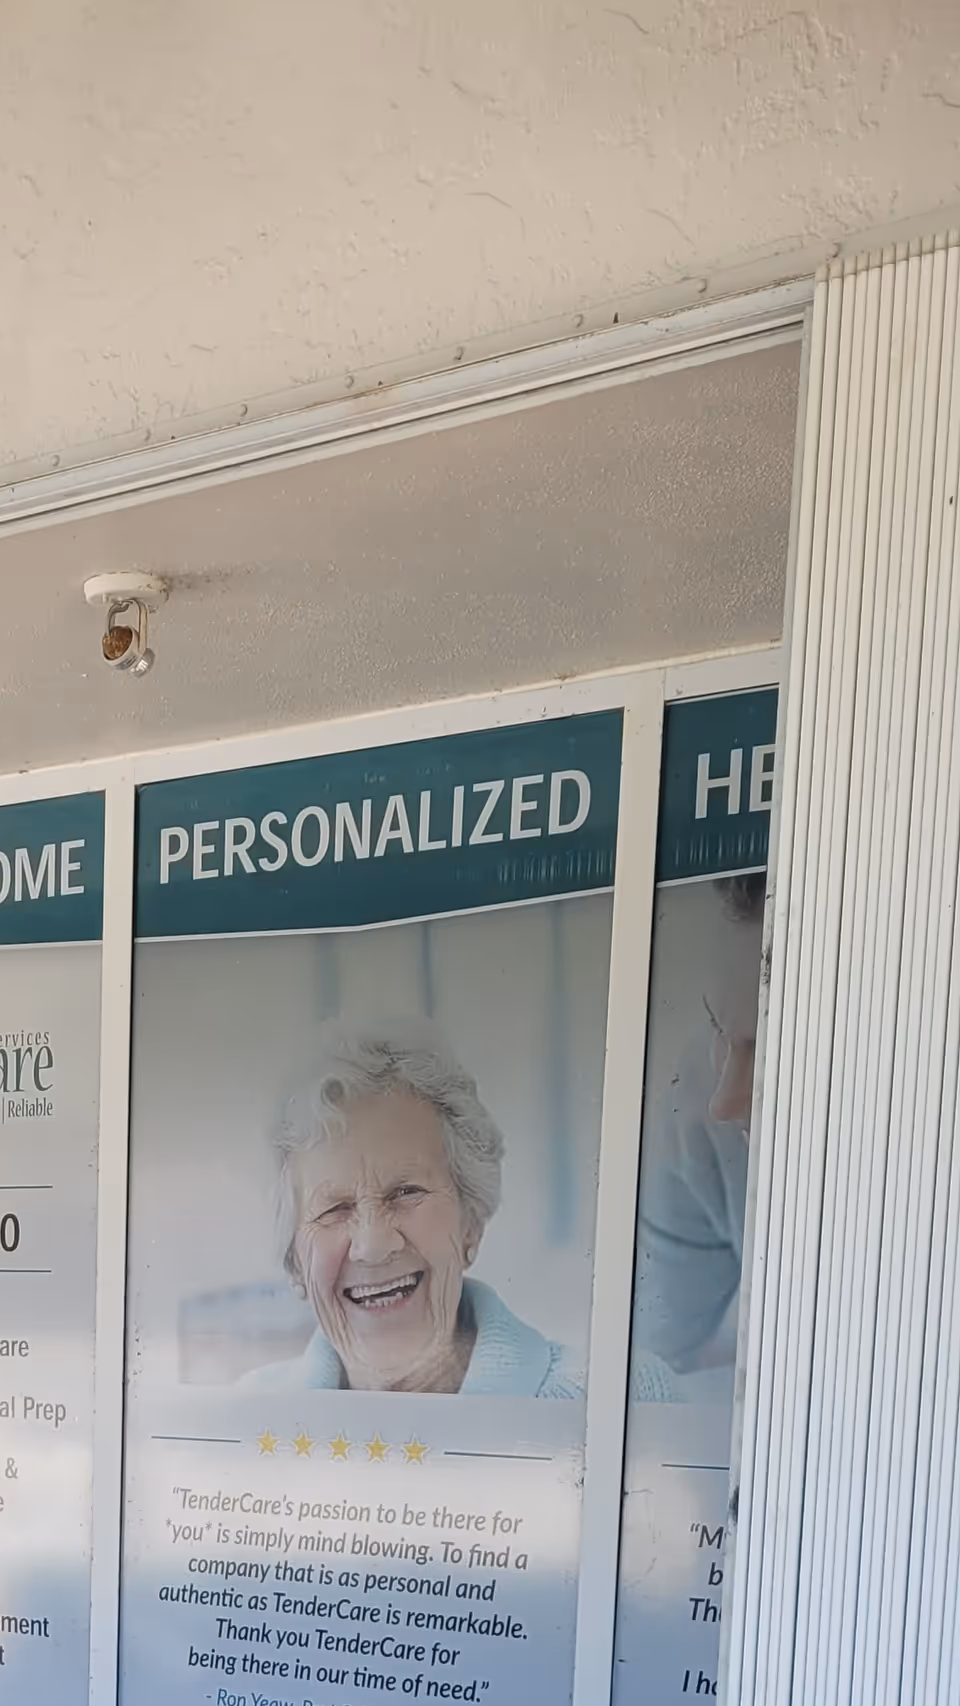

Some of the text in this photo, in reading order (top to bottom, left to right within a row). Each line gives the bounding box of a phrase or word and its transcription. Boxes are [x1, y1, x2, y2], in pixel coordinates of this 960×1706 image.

[159, 768, 592, 884] PERSONALIZED
[8, 1097, 53, 1118] Reliable
[23, 1396, 67, 1428] Prep
[5, 1457, 19, 1479] &
[298, 1500, 371, 1522] passion
[377, 1503, 397, 1524] to
[402, 1503, 426, 1526] be
[432, 1506, 486, 1531] there
[492, 1510, 523, 1536] for
[216, 1522, 230, 1544] is
[234, 1525, 294, 1553] simply
[297, 1531, 347, 1553] mind
[351, 1533, 434, 1566] blowing.
[440, 1541, 463, 1564] To
[468, 1543, 511, 1569] find
[515, 1553, 529, 1570] a
[188, 1557, 496, 1602] company that is as personal and
[159, 1583, 528, 1640] authentic as TenderCare is remarkable.
[689, 1597, 721, 1623] Th
[216, 1618, 460, 1667] Thank you TenderCare for
[188, 1646, 237, 1675] being
[241, 1653, 289, 1678] there
[294, 1659, 312, 1681] in
[316, 1666, 349, 1685] our
[353, 1667, 397, 1691] time
[401, 1675, 424, 1698] of
[682, 1669, 691, 1693] I
